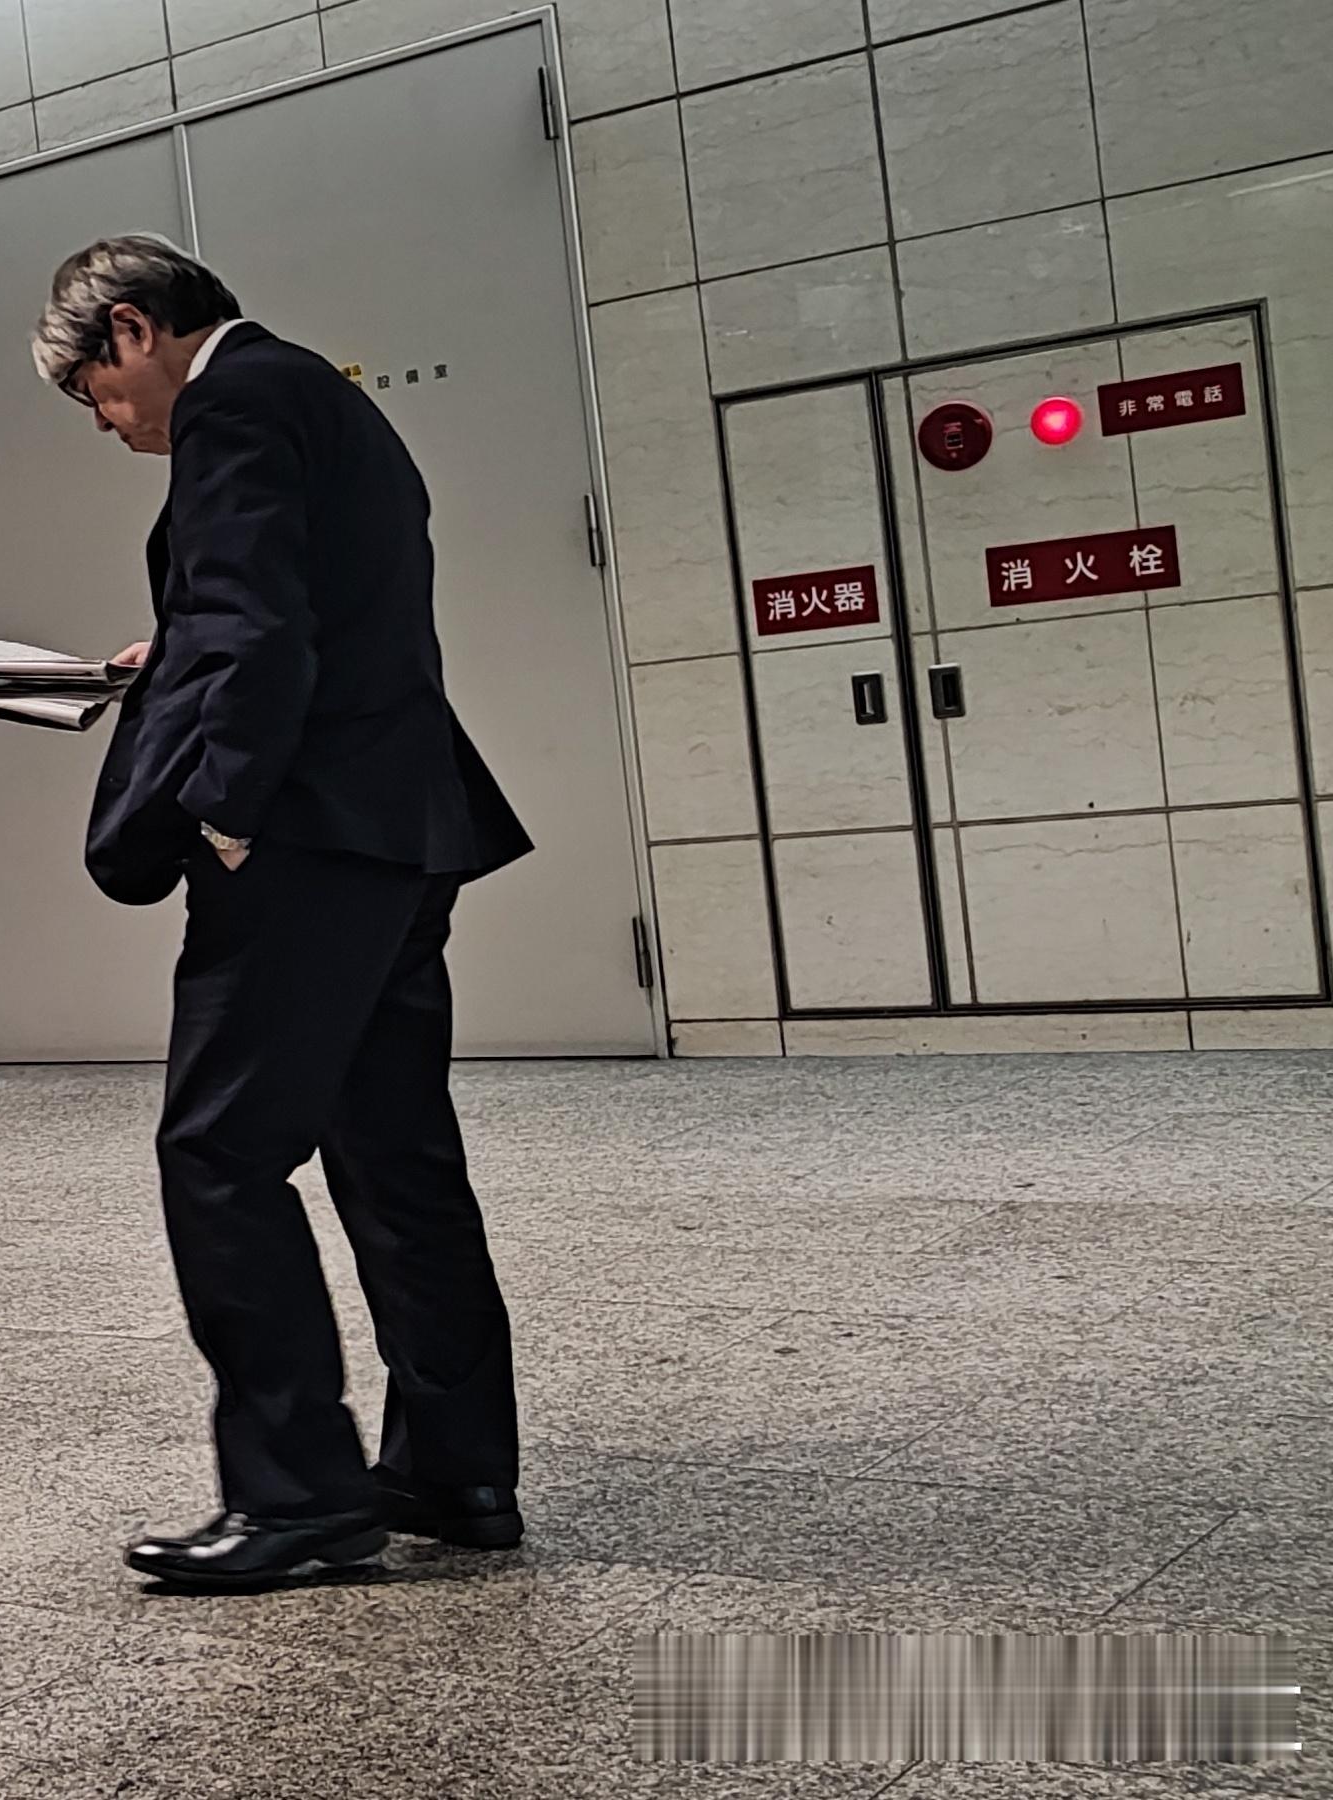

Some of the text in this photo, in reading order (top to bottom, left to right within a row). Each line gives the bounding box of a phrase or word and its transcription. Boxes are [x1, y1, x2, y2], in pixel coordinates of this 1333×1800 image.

[1119, 384, 1223, 417] 非常電話
[1000, 543, 1165, 592] 消火栓
[766, 581, 866, 622] 消火器
